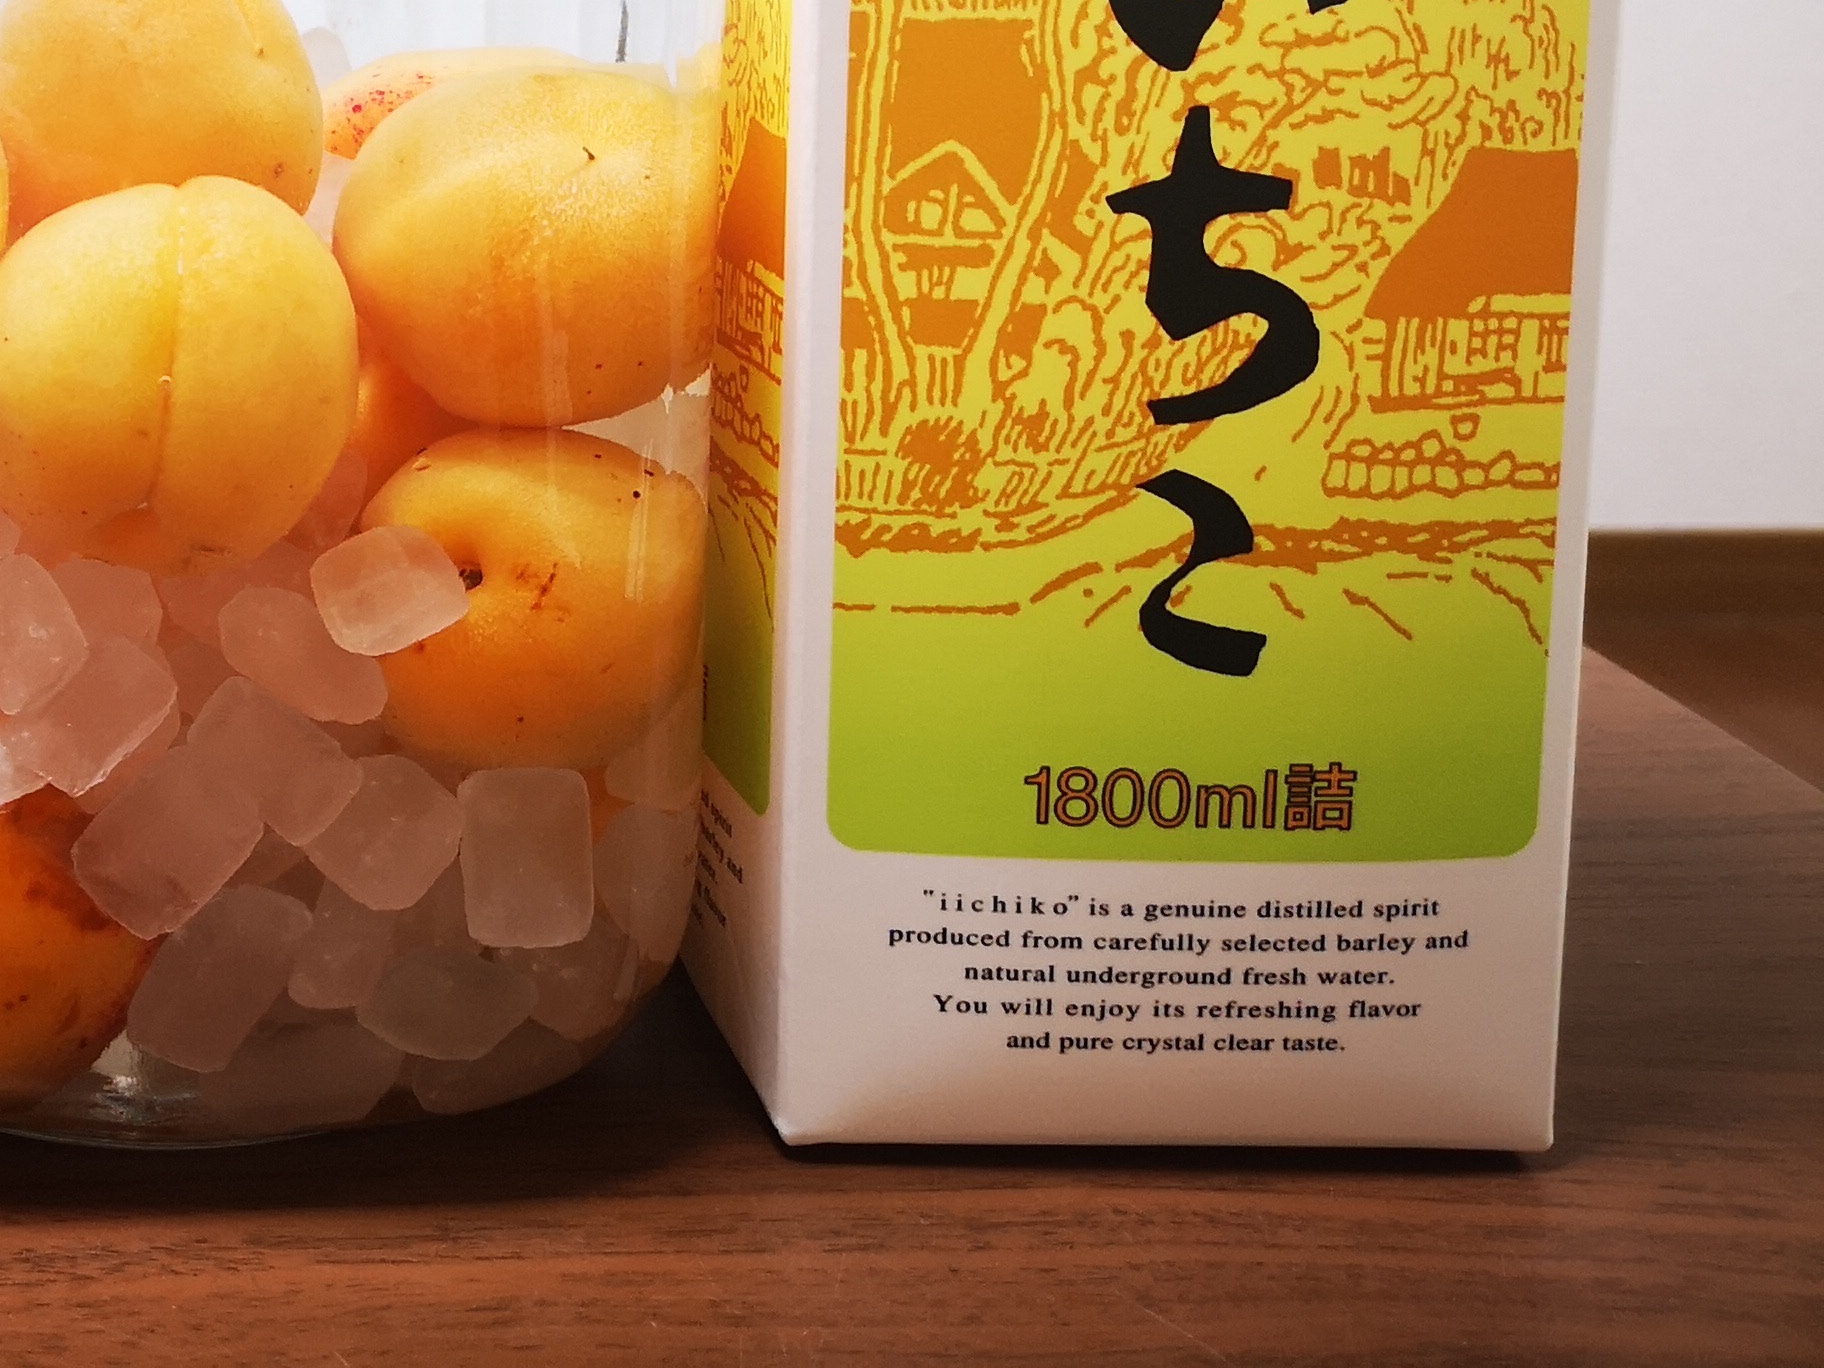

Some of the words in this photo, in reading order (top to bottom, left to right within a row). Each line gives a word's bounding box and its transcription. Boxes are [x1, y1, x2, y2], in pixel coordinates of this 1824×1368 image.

[1023, 761, 1359, 832] 1800ml詰
[922, 888, 1079, 916] "iichiko"
[1089, 897, 1110, 916] is
[1120, 903, 1134, 917] a
[1143, 900, 1246, 922] genuine
[1256, 900, 1363, 919] distilled
[1373, 898, 1439, 923] spirit
[888, 926, 1010, 949] produced
[1021, 930, 1083, 950] from
[1093, 932, 1211, 957] carefully
[1221, 934, 1326, 952] selected
[1336, 933, 1416, 956] barley
[1425, 929, 1469, 950] and
[964, 964, 1055, 983] natural
[1066, 966, 1232, 989] underground
[1243, 967, 1306, 986] fresh
[1317, 969, 1396, 986] water.
[933, 994, 988, 1014] You
[1000, 998, 1053, 1016] will
[1065, 999, 1140, 1022] enjoy
[1153, 999, 1185, 1018] its
[1196, 1000, 1336, 1024] refreshing
[1348, 999, 1422, 1018] flavor
[1006, 1031, 1051, 1050] and
[1059, 1036, 1114, 1055] pure
[1122, 1033, 1205, 1055] crystal
[1213, 1033, 1275, 1052] clear
[1282, 1036, 1346, 1052] taste.
